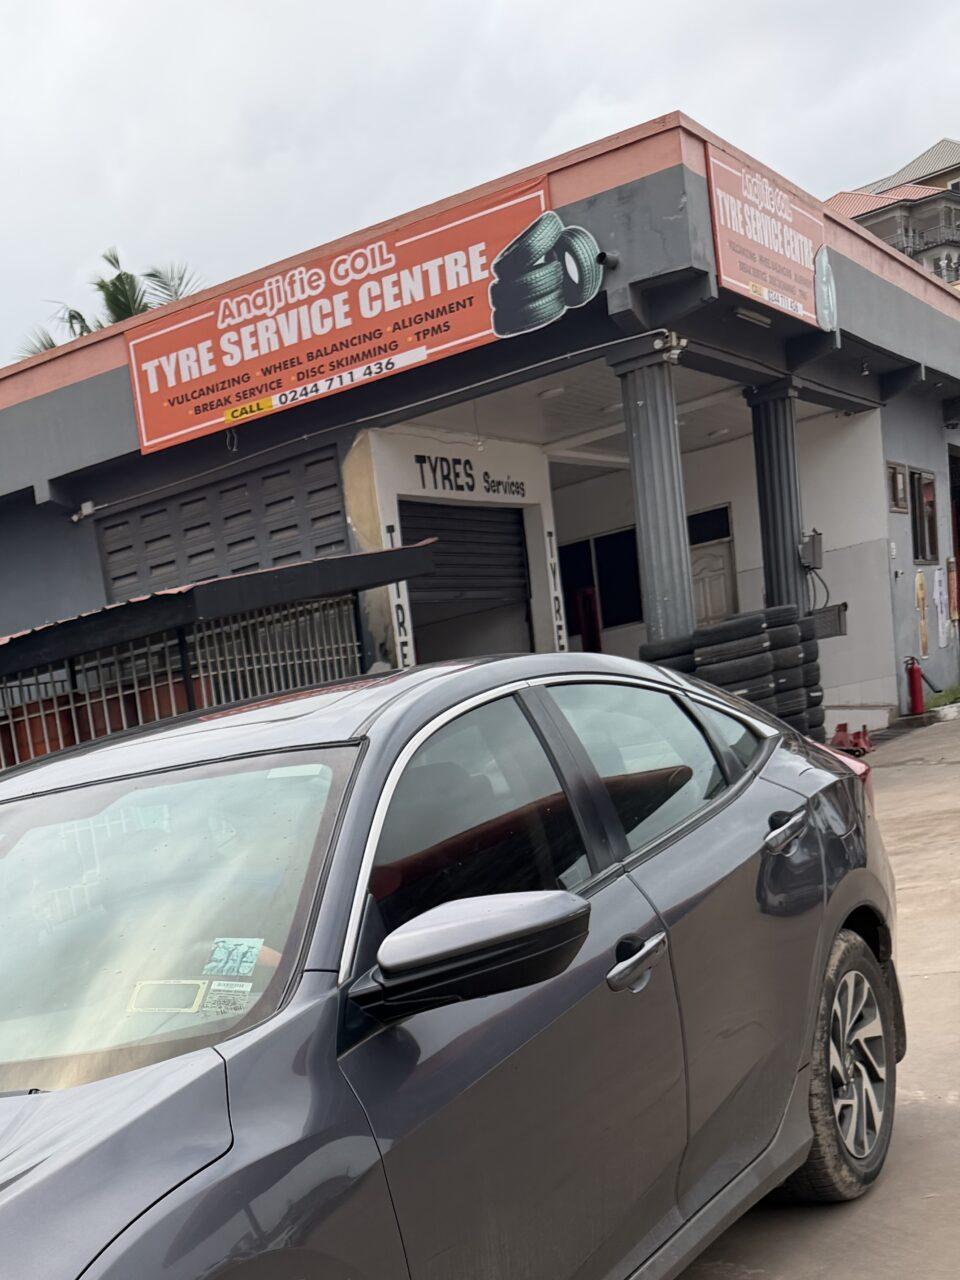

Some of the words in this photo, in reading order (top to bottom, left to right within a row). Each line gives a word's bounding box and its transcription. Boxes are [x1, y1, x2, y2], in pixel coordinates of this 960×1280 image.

[716, 188, 745, 235] TYRE
[743, 203, 784, 255] SERVICE
[142, 340, 217, 394] TYRE
[219, 294, 353, 367] SERVICE
[358, 242, 489, 320] CENTRE
[168, 373, 251, 407] VULCANIZING
[261, 356, 303, 377] WHEEL
[306, 329, 384, 362] BALANCING
[392, 296, 475, 333] ALIGNMENT
[194, 396, 232, 415] BREAK
[235, 379, 283, 400] SERVICE
[296, 365, 325, 382] DISC
[328, 340, 399, 371] SKIMMING
[414, 321, 451, 342] TPMS
[230, 402, 264, 419] CALL
[278, 383, 320, 405] 0244
[325, 371, 356, 390] 711
[363, 358, 395, 378] 436
[415, 454, 475, 492] TYRES
[483, 471, 525, 497] Services
